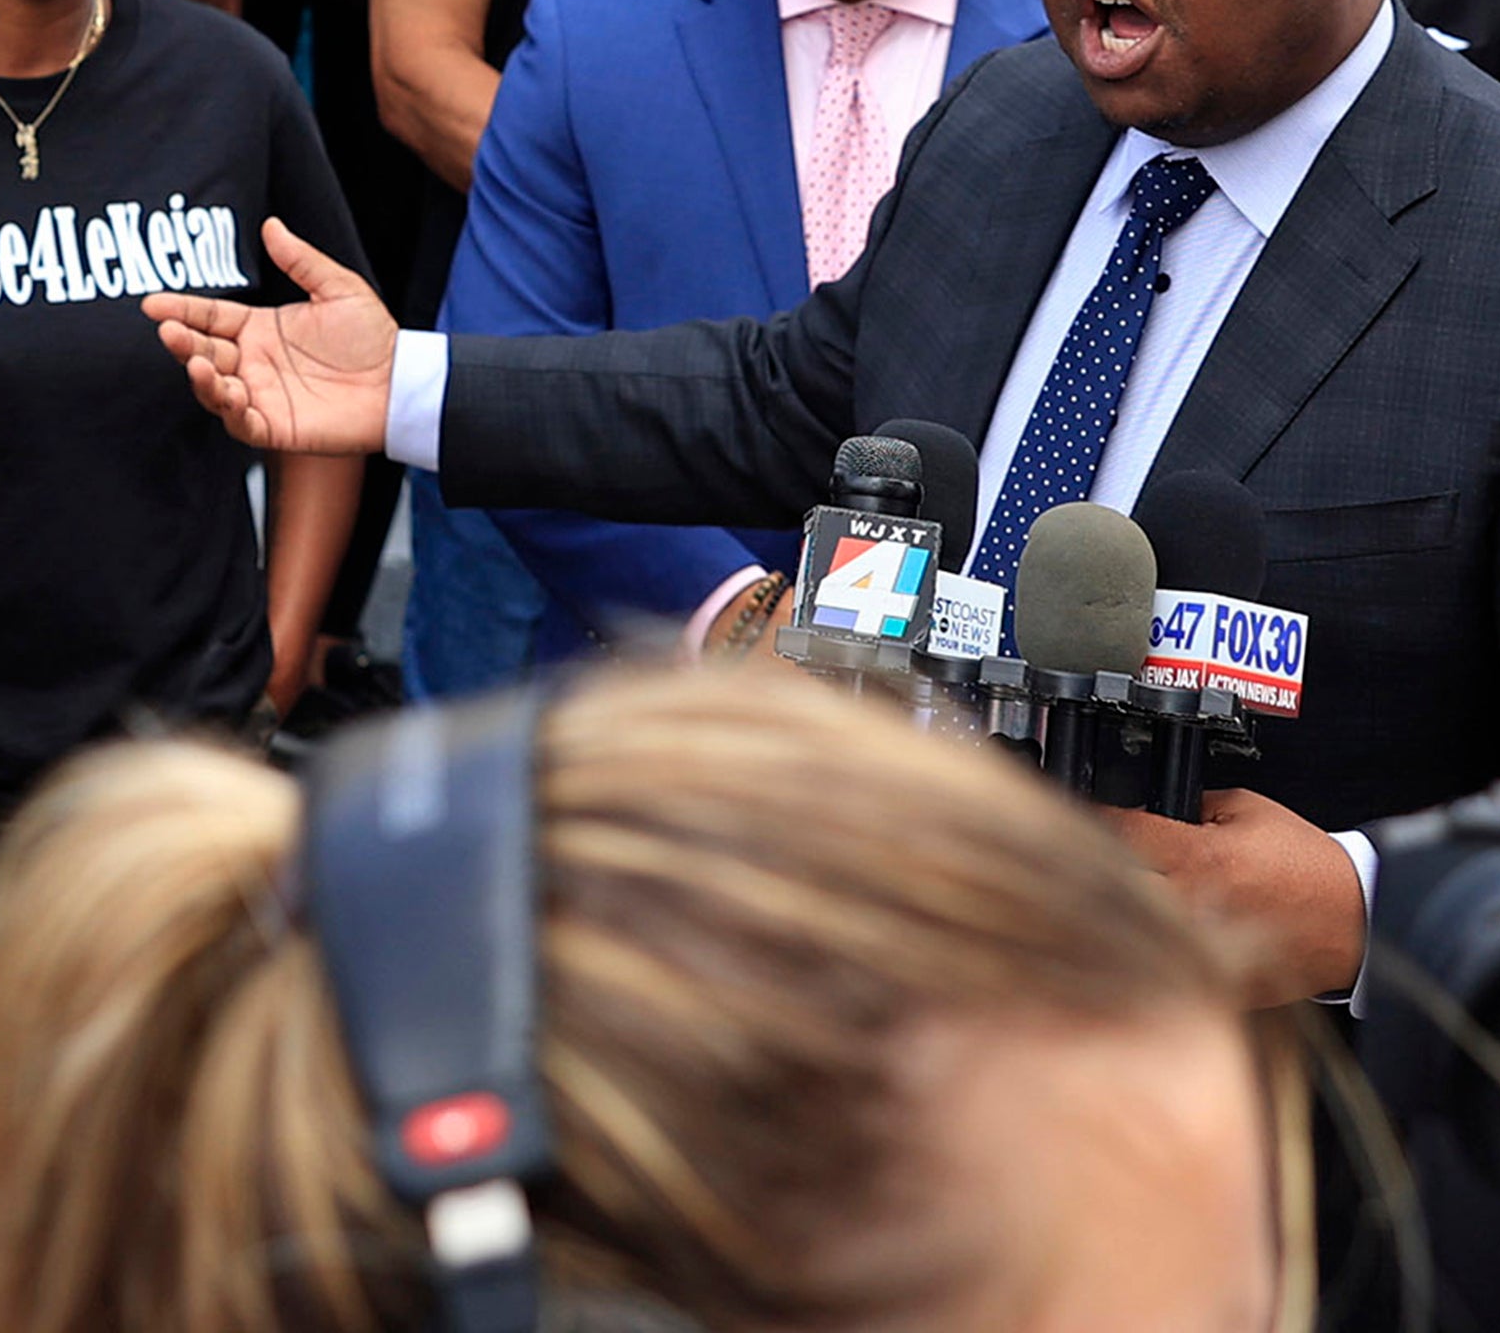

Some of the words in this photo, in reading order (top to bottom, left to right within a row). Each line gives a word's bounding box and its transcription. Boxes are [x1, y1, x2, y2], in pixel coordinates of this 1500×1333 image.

[849, 519, 928, 545] WJXT
[814, 539, 919, 637] 4
[951, 622, 992, 645] NEWS
[1164, 602, 1206, 650] 47
[935, 638, 959, 651] YOUR
[1173, 668, 1200, 689] JAX
[1207, 673, 1246, 700] ACTION
[1245, 681, 1278, 706] NEWS
[1276, 687, 1298, 710] JAX
